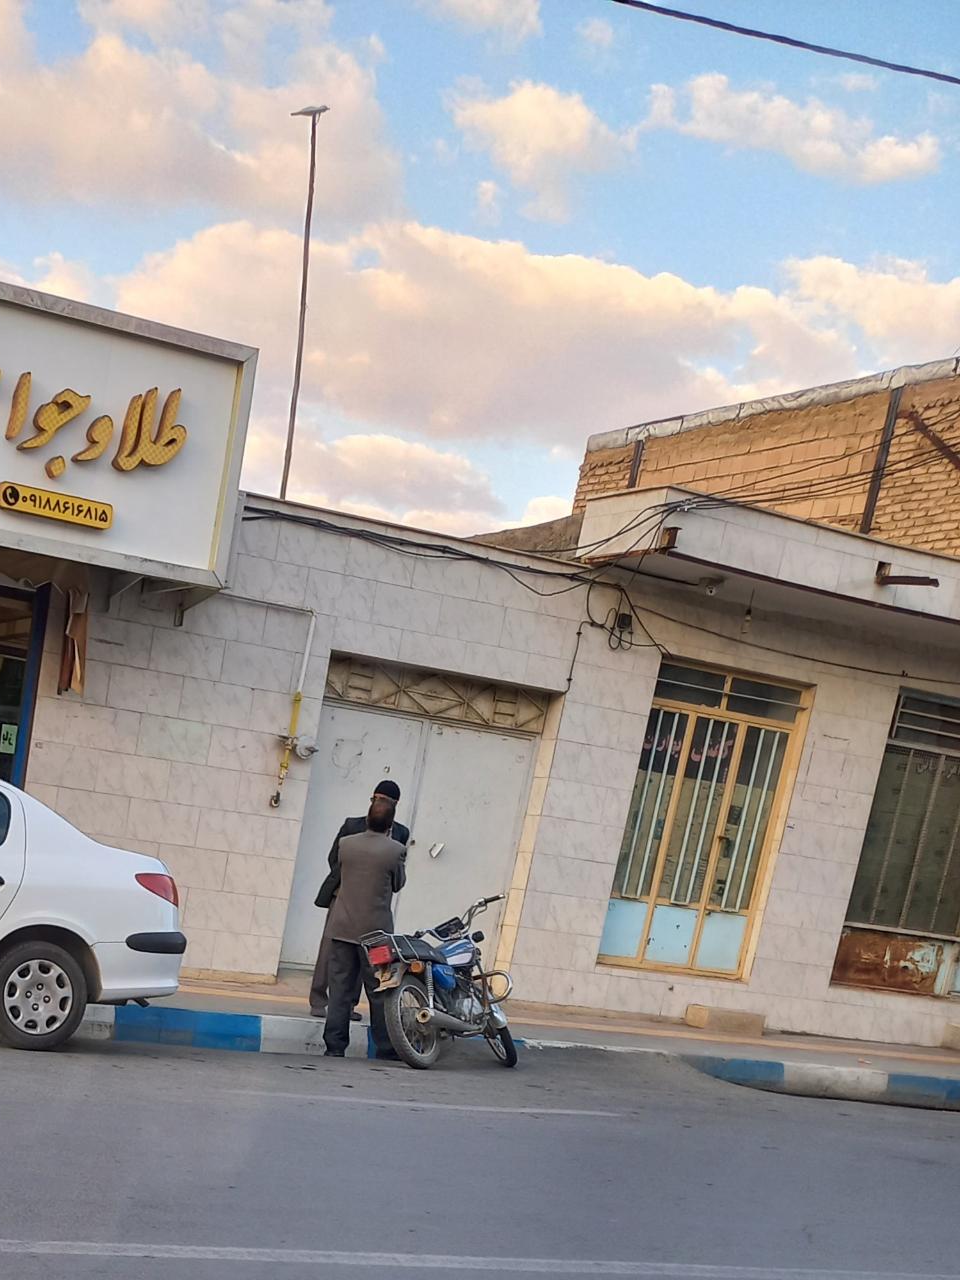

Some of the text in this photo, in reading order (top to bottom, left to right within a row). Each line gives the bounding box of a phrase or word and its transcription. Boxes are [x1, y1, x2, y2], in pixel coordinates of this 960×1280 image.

[71, 414, 113, 463] و
[111, 385, 188, 472] طلا
[21, 493, 109, 522] ۰۹۱۸۸۶۱۶۸۱۵
